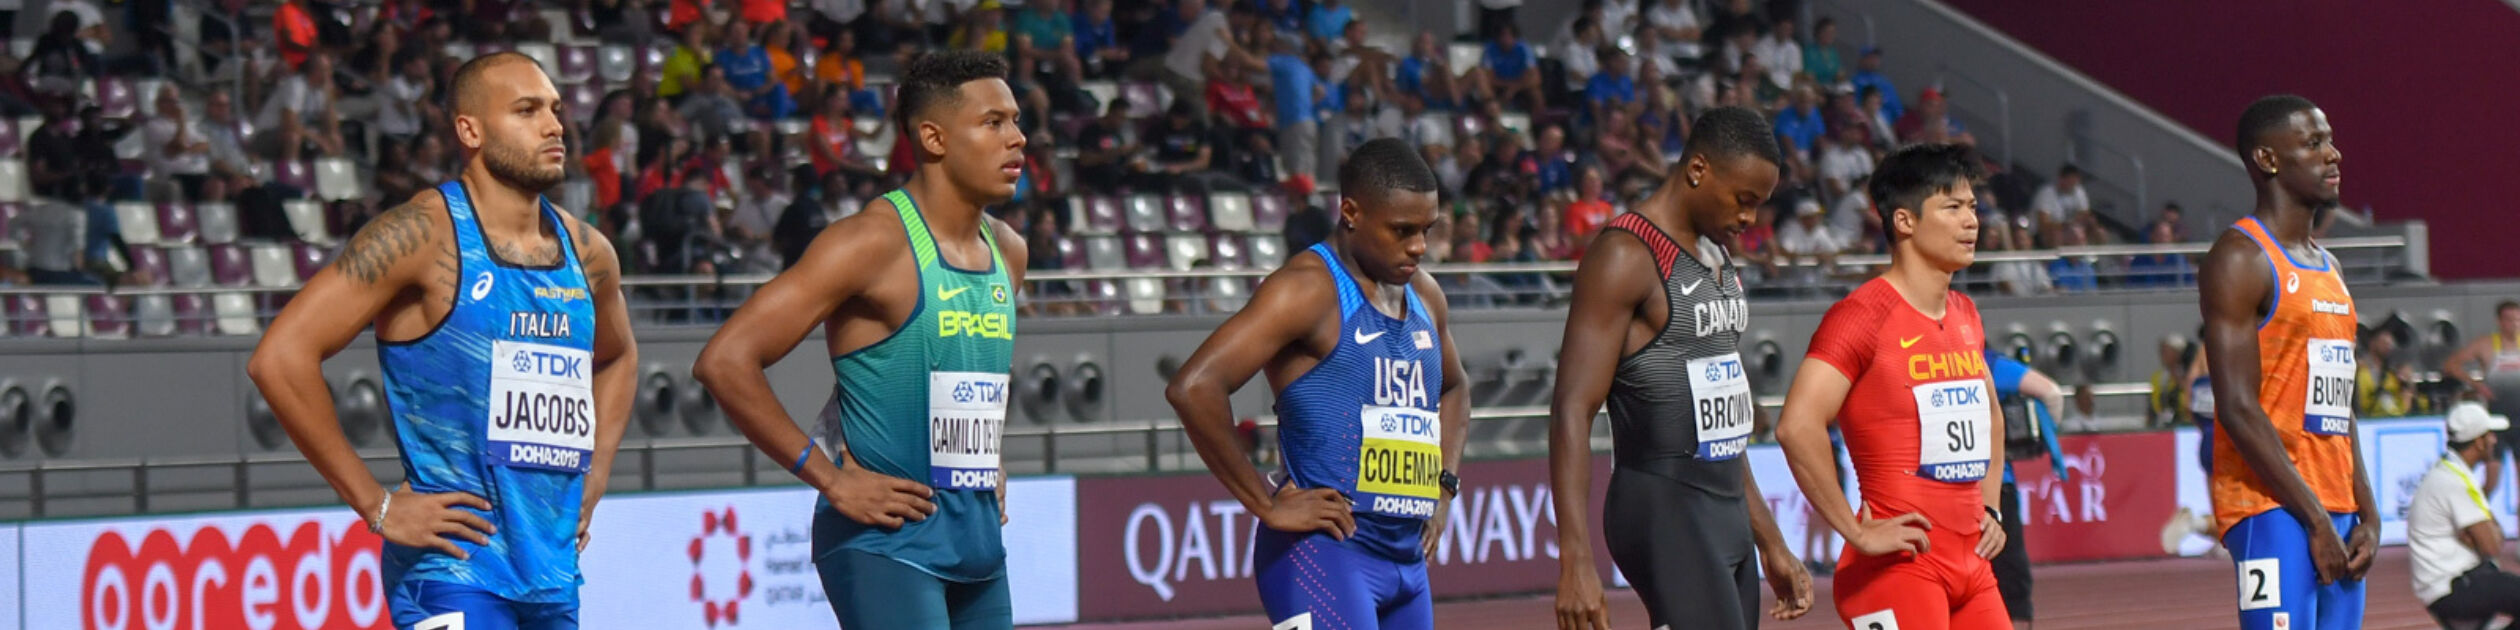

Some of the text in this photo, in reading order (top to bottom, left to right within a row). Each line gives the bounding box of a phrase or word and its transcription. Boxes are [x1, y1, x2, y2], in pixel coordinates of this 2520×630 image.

[509, 311, 571, 338] ITALIA
[937, 310, 1013, 340] BRASIL
[531, 351, 582, 380] TDK
[1908, 350, 1986, 380] CHINA
[1374, 356, 1428, 408] USA
[1943, 386, 1981, 406] TDK
[495, 390, 590, 437] JACOBS
[1396, 414, 1434, 438] TDK
[1699, 390, 1752, 432] BROWN
[931, 416, 980, 455] CAMILO
[1946, 419, 1975, 453] SU
[509, 443, 580, 468] DOHA2019
[2249, 567, 2268, 602] 2
